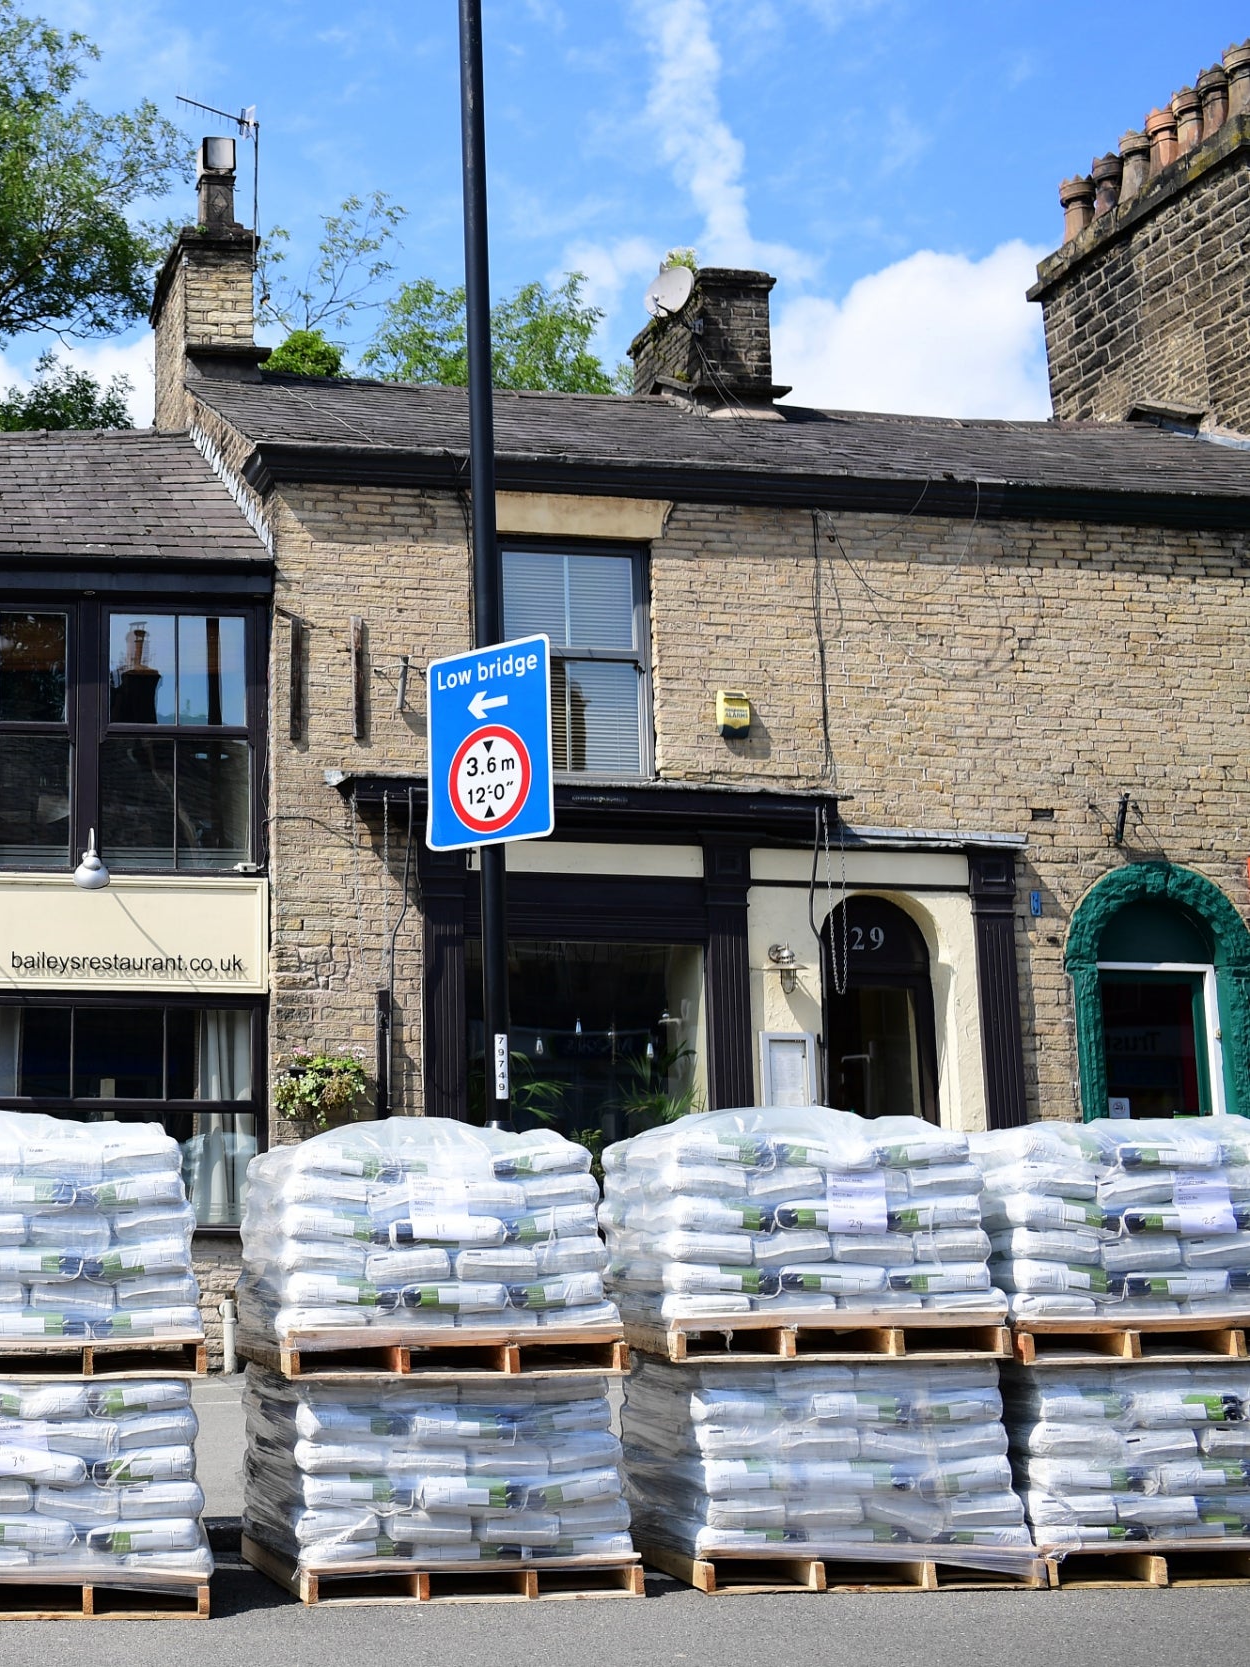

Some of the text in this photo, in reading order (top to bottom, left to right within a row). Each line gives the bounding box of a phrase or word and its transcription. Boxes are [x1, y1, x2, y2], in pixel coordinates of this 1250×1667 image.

[437, 653, 538, 691] Low bridge
[466, 756, 496, 777] 3.6
[850, 926, 885, 951] 29
[10, 951, 244, 973] baileysrestaurant.co.uk
